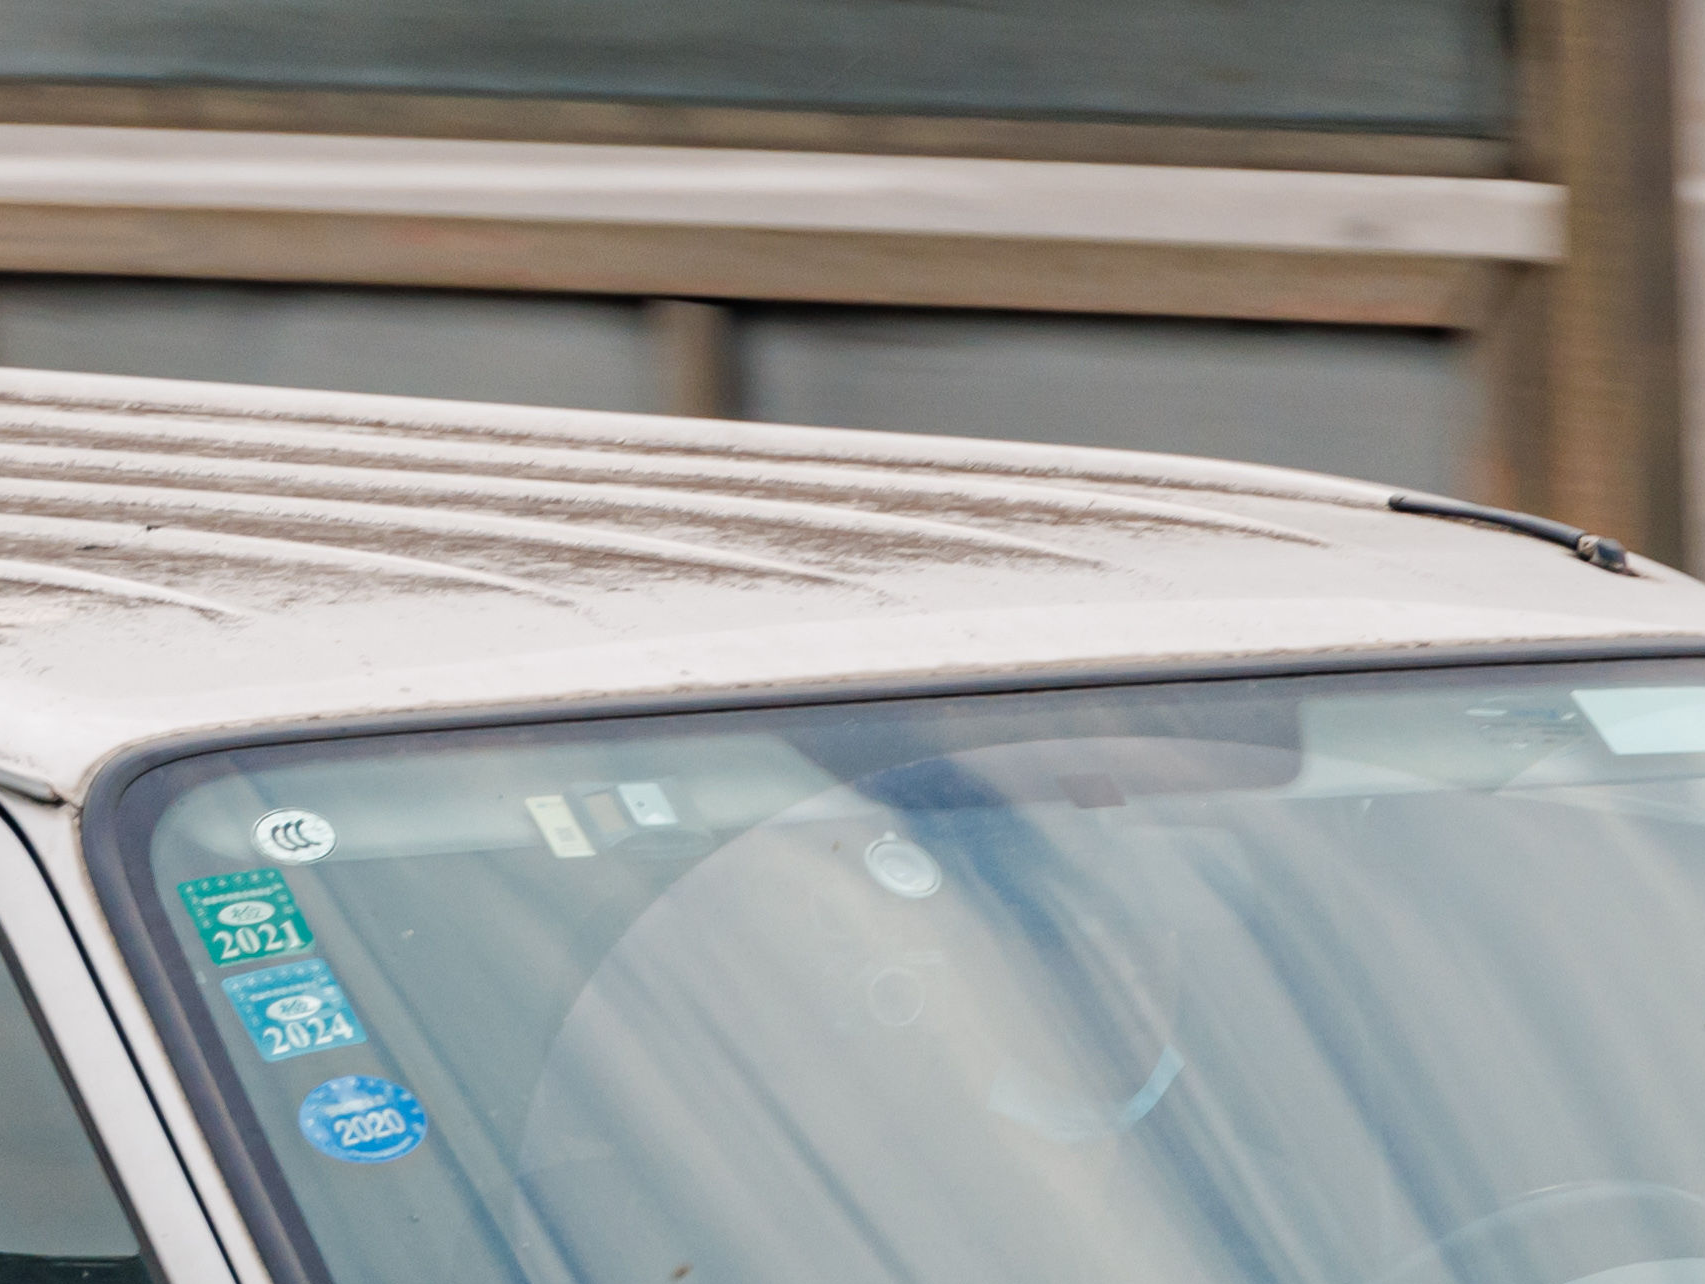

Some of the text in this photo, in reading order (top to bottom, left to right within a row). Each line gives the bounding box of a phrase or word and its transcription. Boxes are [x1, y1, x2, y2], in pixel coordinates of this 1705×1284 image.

[212, 920, 306, 960] 2021
[262, 1012, 354, 1055] 2024
[334, 1108, 406, 1147] 2020
